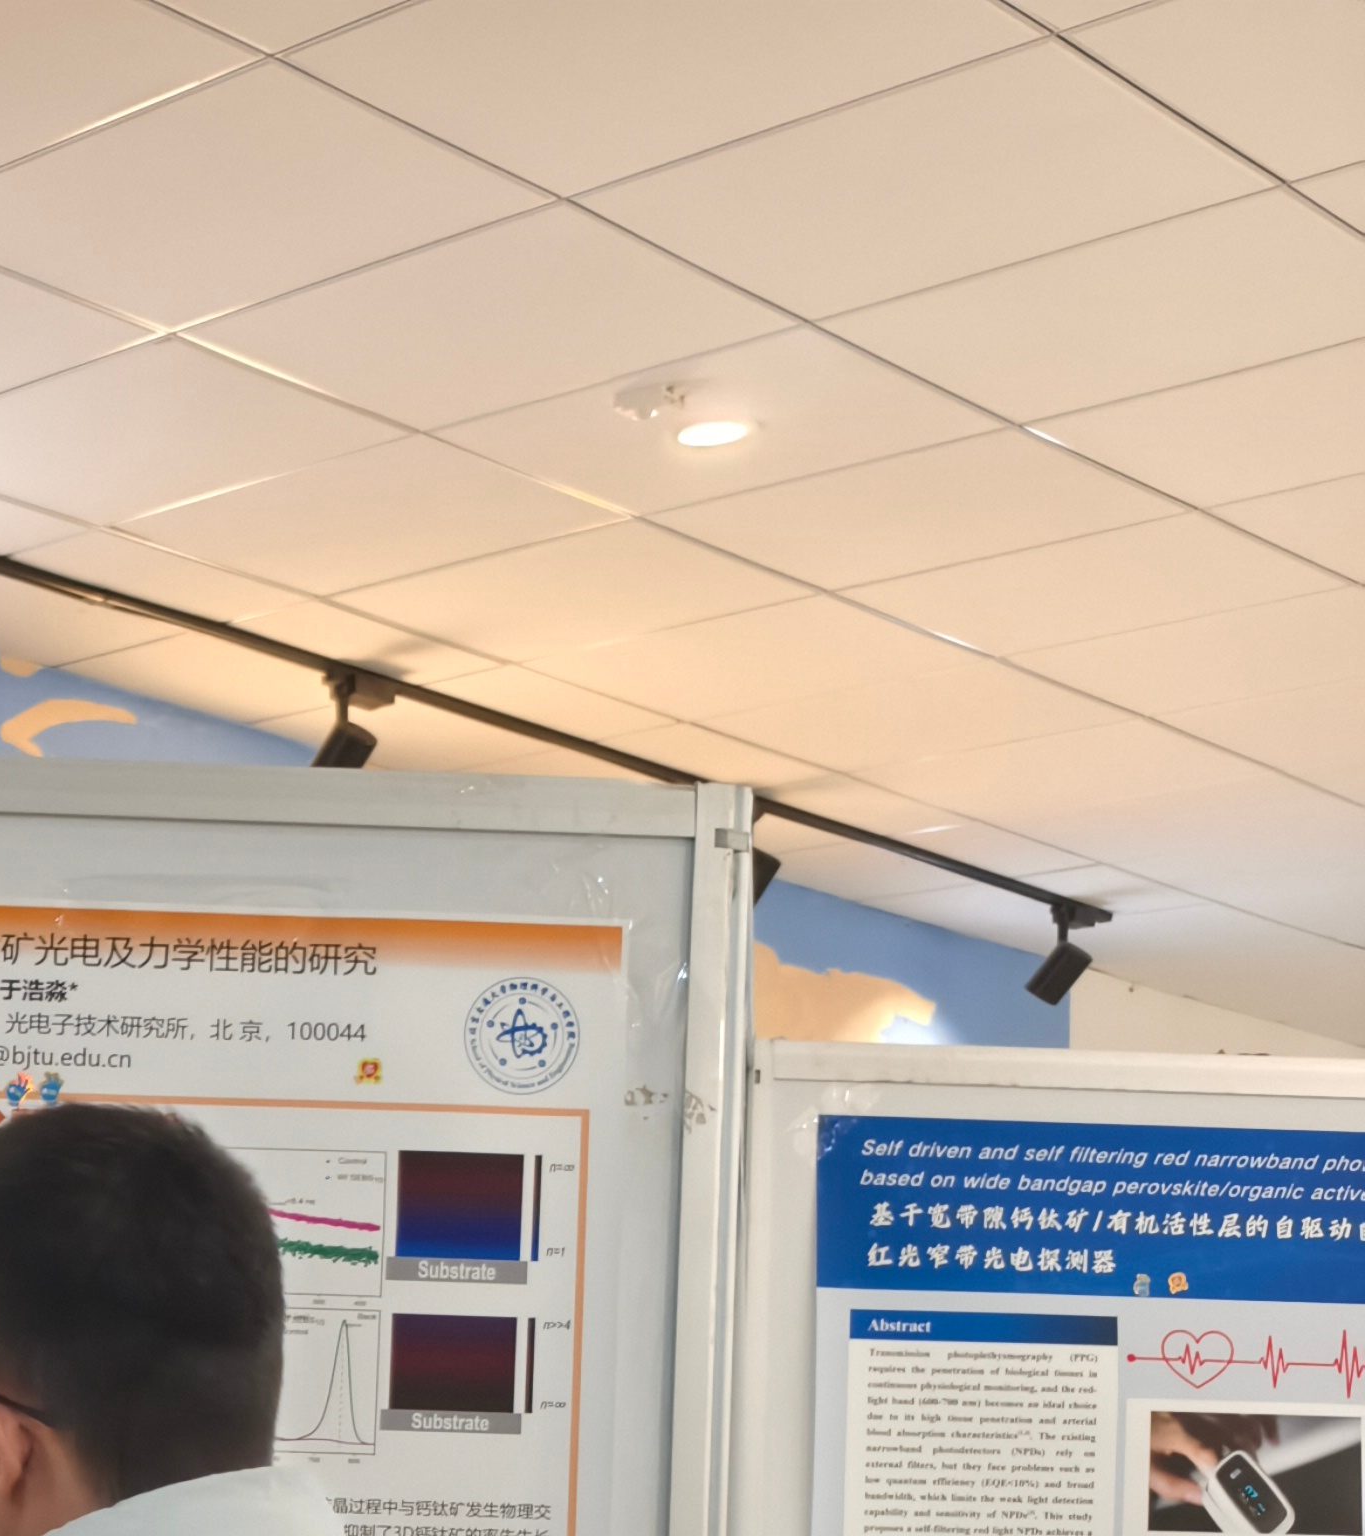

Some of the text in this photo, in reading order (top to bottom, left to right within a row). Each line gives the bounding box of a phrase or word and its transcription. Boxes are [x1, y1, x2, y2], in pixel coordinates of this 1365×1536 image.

[861, 1139, 1365, 1176] Self driven and self filtering red narrowband pho
[860, 1169, 925, 1188] based
[930, 1173, 955, 1189] on
[963, 1172, 1012, 1191] wide
[1017, 1173, 1108, 1196] bandgap
[1112, 1176, 1305, 1201] perovskite/organic
[866, 1242, 1117, 1275] 红光窄带光电探测器
[417, 1260, 496, 1282] Substrate
[867, 1319, 932, 1333] Abstract
[411, 1411, 489, 1432] Substrate
[326, 1497, 552, 1521] 晶过程中与钙钛矿发生物理交
